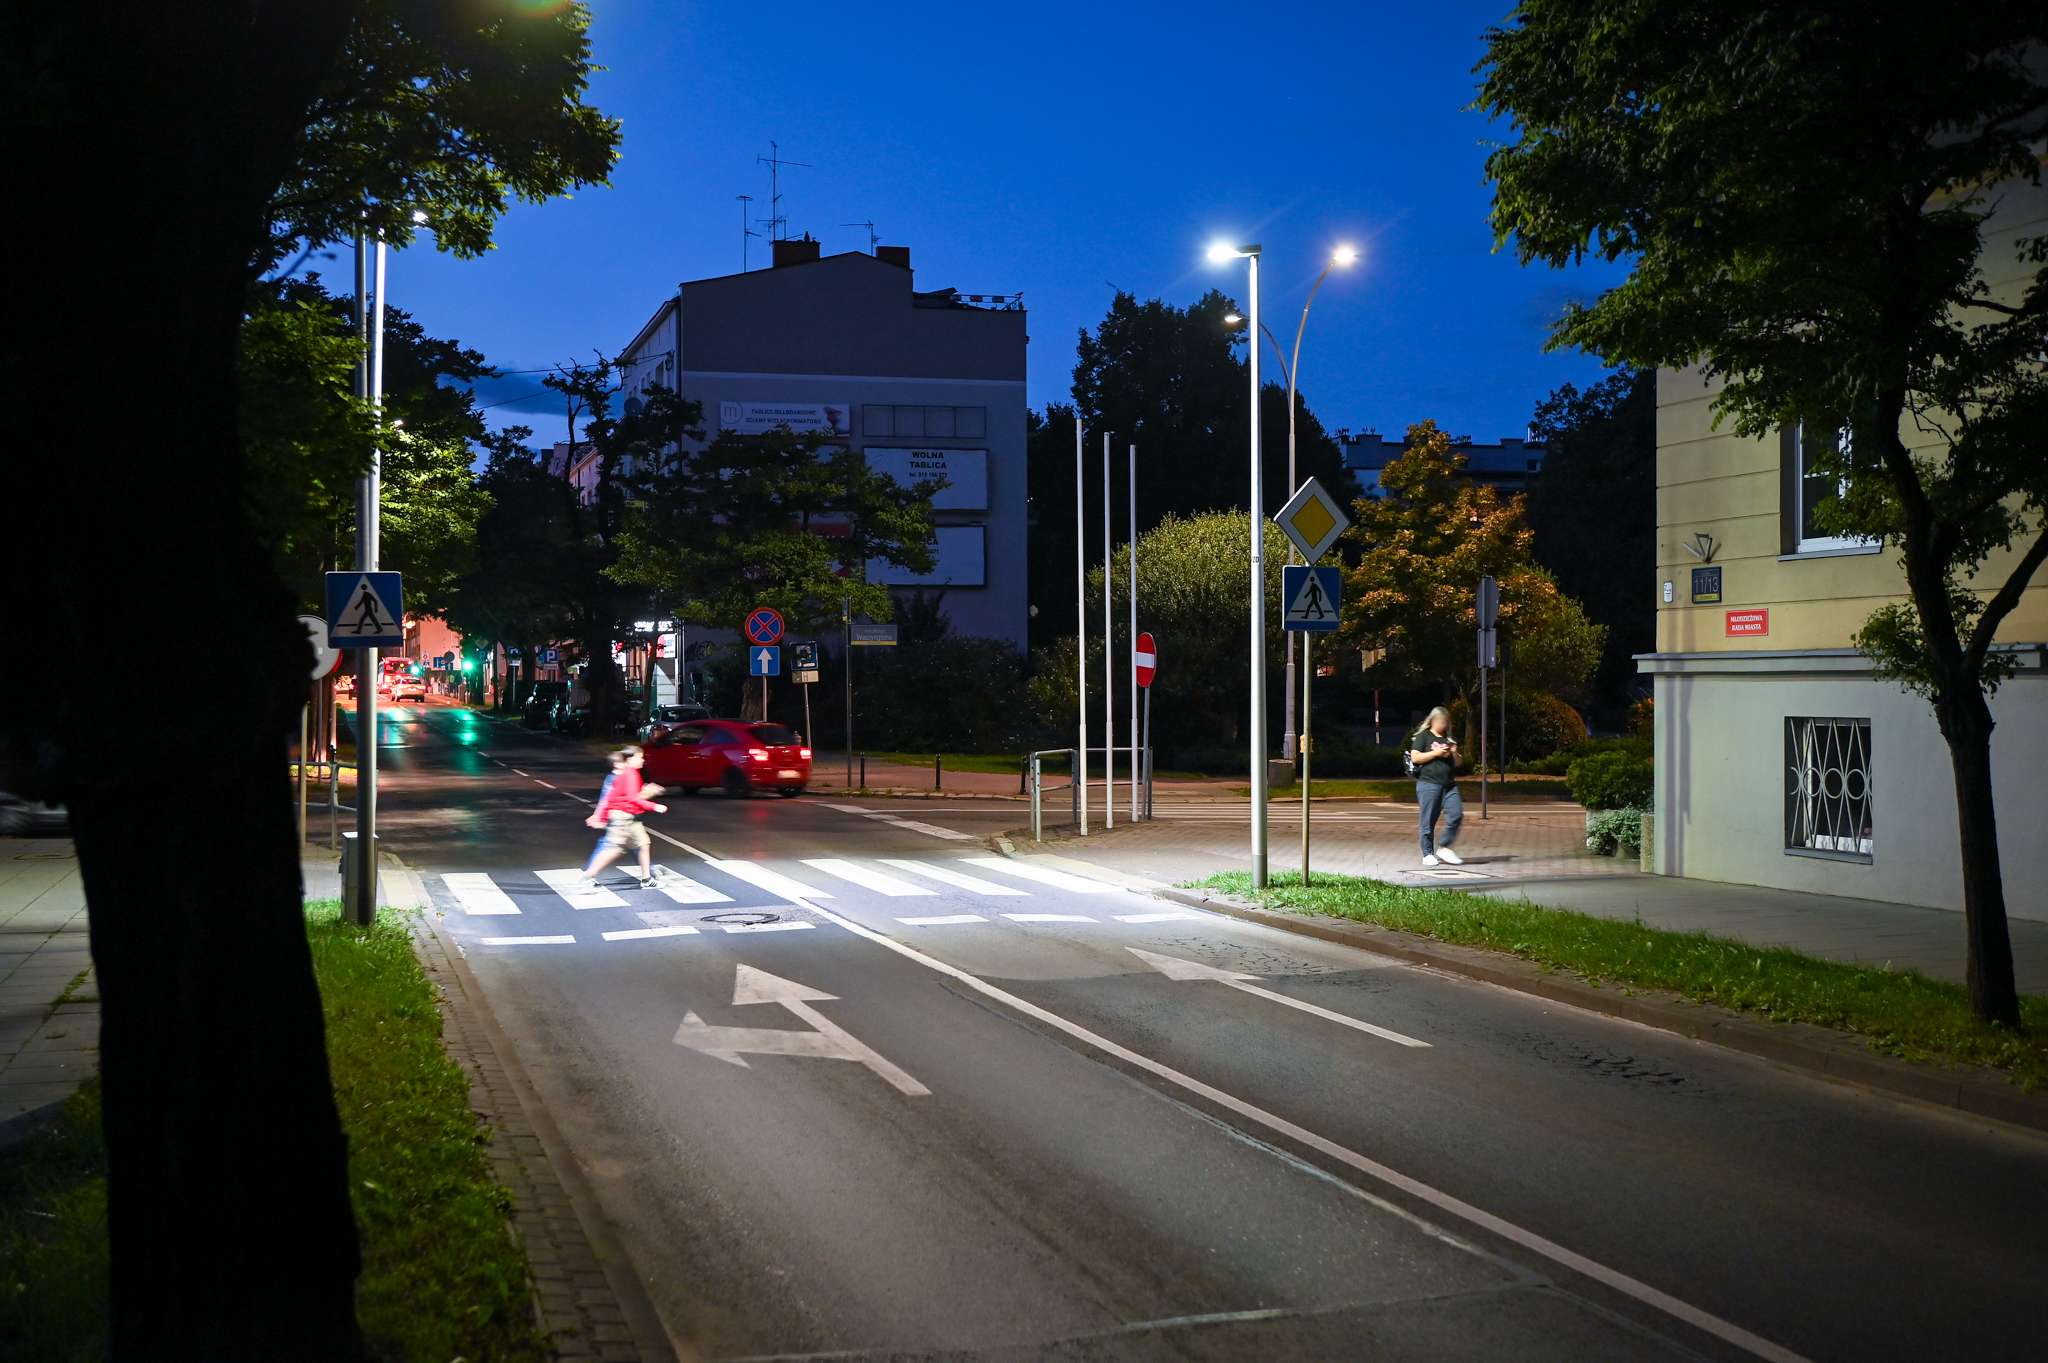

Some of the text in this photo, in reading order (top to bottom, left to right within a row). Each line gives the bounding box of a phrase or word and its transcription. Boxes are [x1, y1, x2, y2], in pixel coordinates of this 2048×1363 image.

[912, 450, 944, 459] WOLNA
[910, 461, 947, 469] TABLICA
[1696, 575, 1719, 593] 11/13
